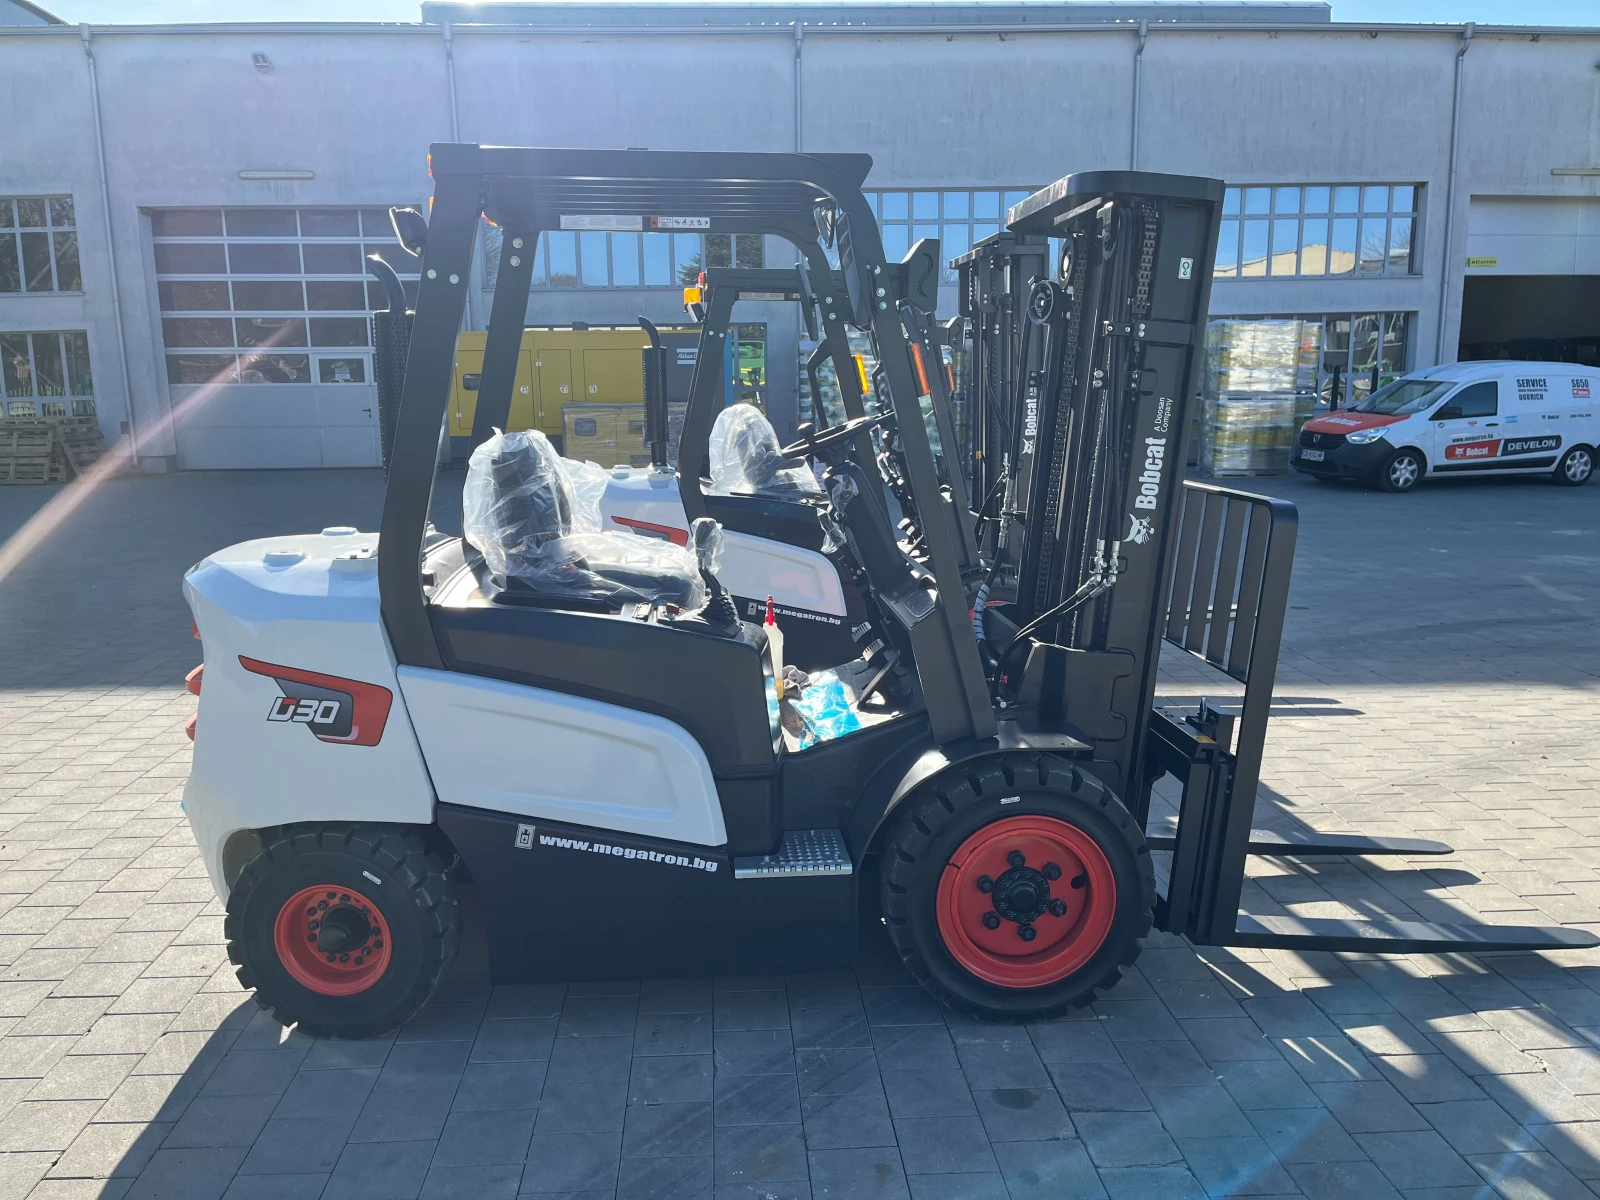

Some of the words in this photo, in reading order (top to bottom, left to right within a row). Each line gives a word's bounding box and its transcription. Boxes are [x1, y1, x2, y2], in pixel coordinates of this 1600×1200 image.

[1517, 379, 1547, 388] SERVICE
[1571, 379, 1589, 388] S650
[1025, 399, 1037, 436] Bobcat
[1155, 397, 1165, 424] Doosan
[1161, 398, 1173, 432] Company
[1466, 447, 1488, 456] Bobcat
[1507, 439, 1556, 451] DEVELON
[1135, 437, 1167, 509] Bobcat
[758, 604, 841, 625] ww.megatron.bg
[266, 696, 341, 724] D30
[539, 834, 718, 872] www.megatron.bg
